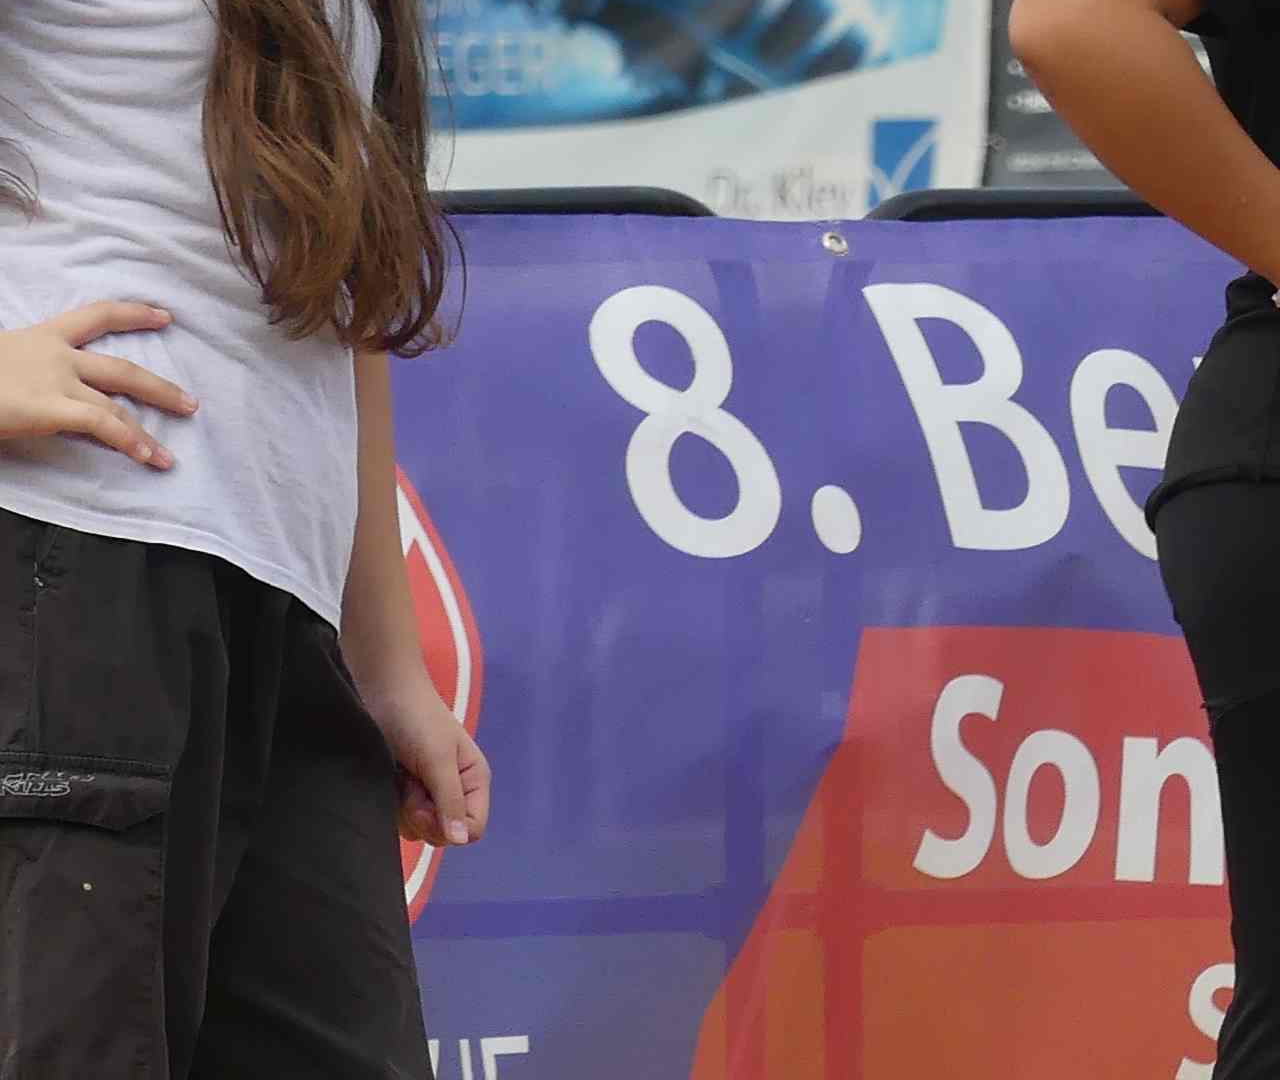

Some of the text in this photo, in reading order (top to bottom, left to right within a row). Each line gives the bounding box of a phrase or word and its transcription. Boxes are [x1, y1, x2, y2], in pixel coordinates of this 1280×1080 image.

[588, 282, 1182, 561] 8. Be
[912, 673, 1225, 886] Son
